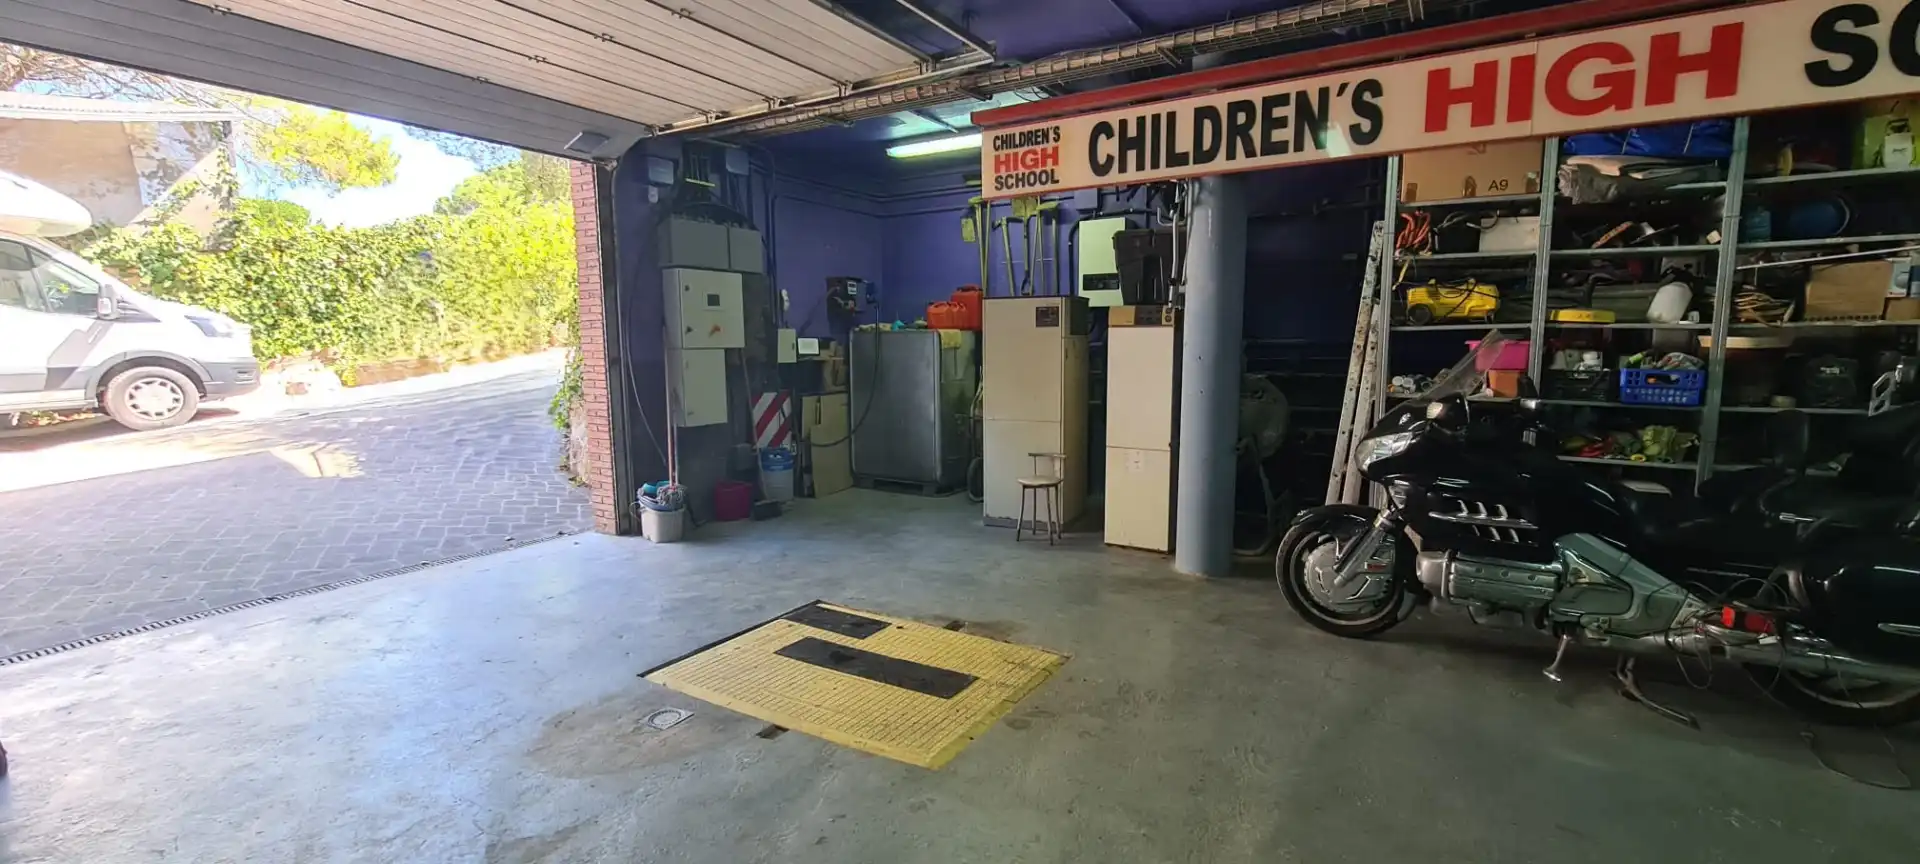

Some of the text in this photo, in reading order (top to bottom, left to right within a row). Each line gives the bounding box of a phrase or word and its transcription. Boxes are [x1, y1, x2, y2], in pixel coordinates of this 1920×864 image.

[1423, 22, 1744, 134] HIGH
[994, 145, 1060, 174] HIGH
[994, 169, 1060, 191] SCHOOL
[1488, 179, 1509, 191] A9
